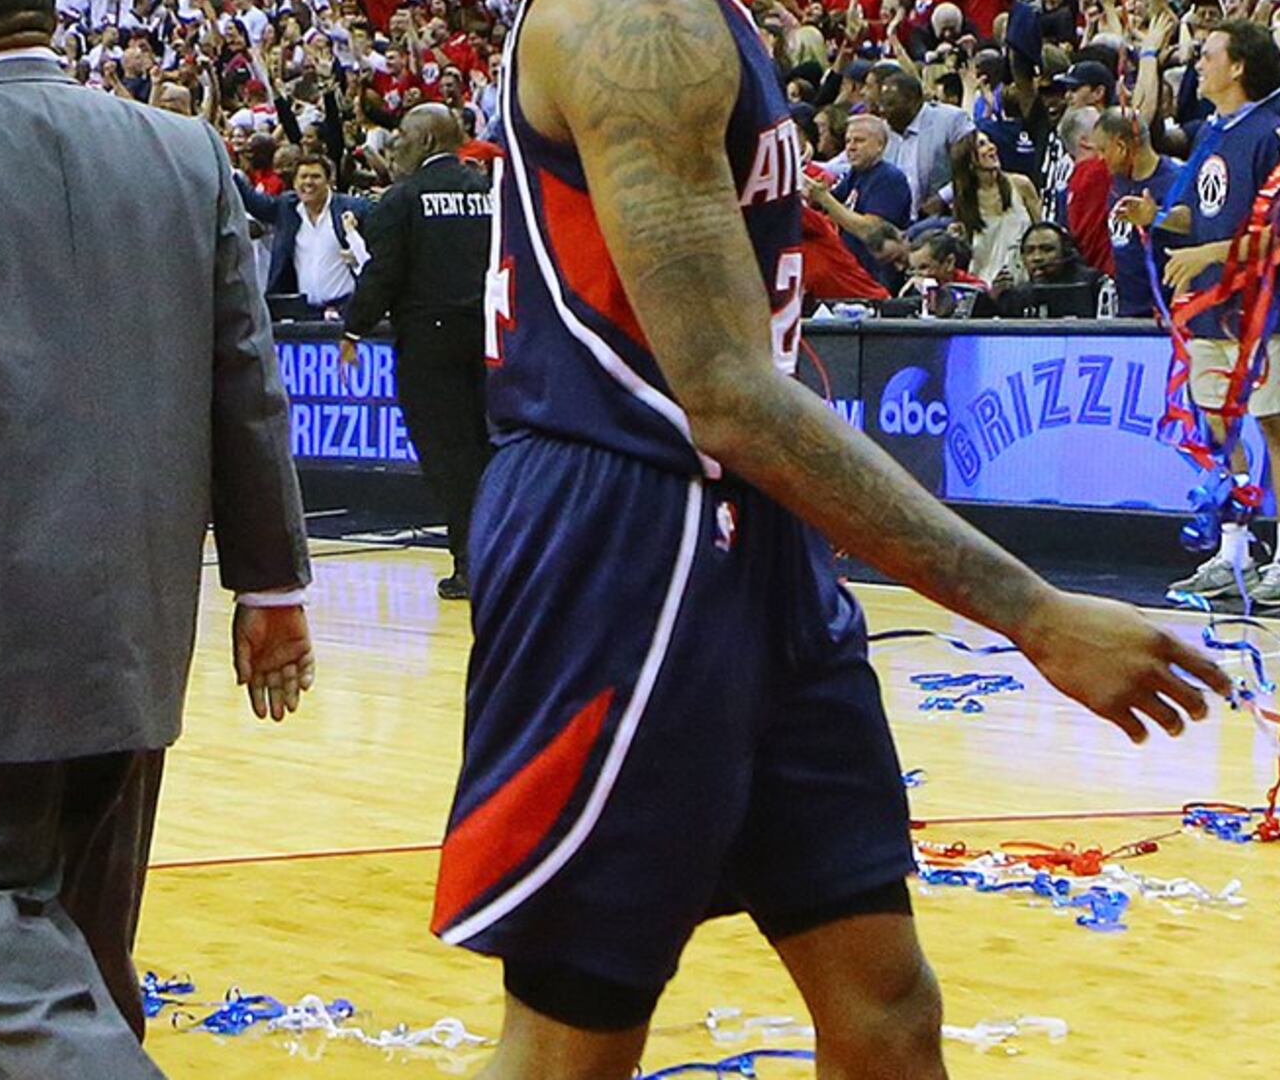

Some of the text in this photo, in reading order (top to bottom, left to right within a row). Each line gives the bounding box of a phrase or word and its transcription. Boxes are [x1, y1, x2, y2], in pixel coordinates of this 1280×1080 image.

[421, 192, 465, 217] EVENT
[771, 251, 803, 375] 2
[274, 343, 394, 398] ARRIOR
[880, 389, 948, 436] abc
